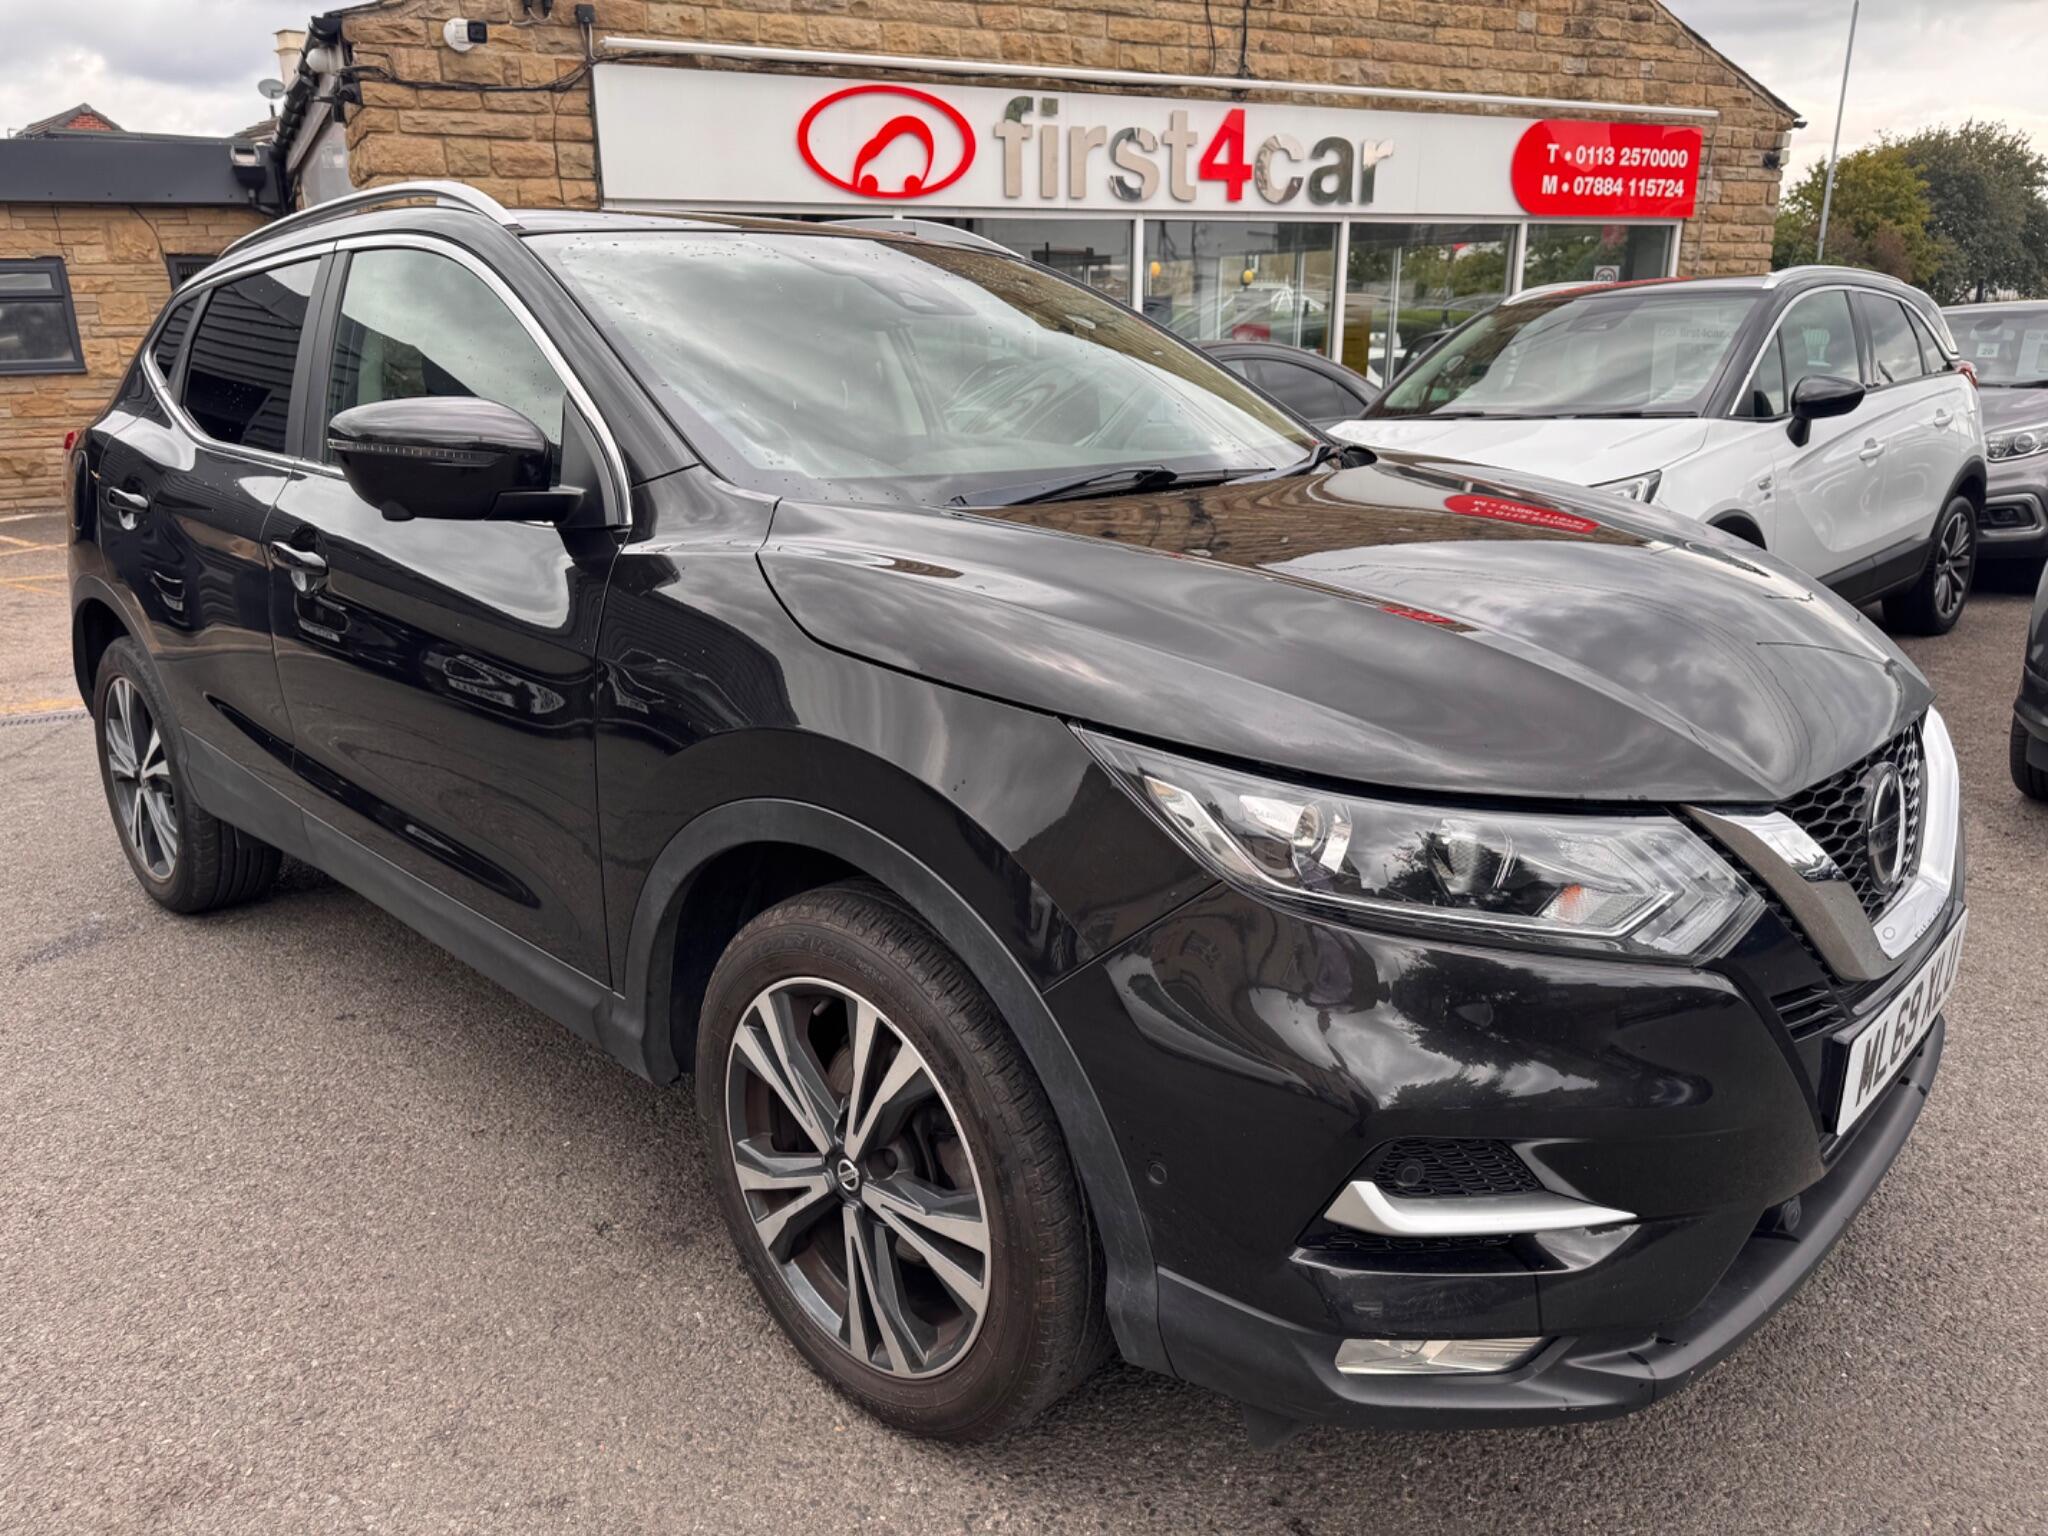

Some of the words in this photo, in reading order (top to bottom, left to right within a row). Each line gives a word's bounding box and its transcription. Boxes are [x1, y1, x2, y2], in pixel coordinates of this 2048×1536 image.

[994, 95, 1394, 205] first4car
[1547, 143, 1560, 164] T
[1575, 145, 1615, 165] 0113
[1619, 148, 1688, 168] 2570000
[1541, 175, 1558, 195] M
[1573, 176, 1623, 196] 07884
[1628, 178, 1685, 198] 115724
[1855, 980, 1924, 1108] ML69
[1919, 928, 1962, 1028] XLU
